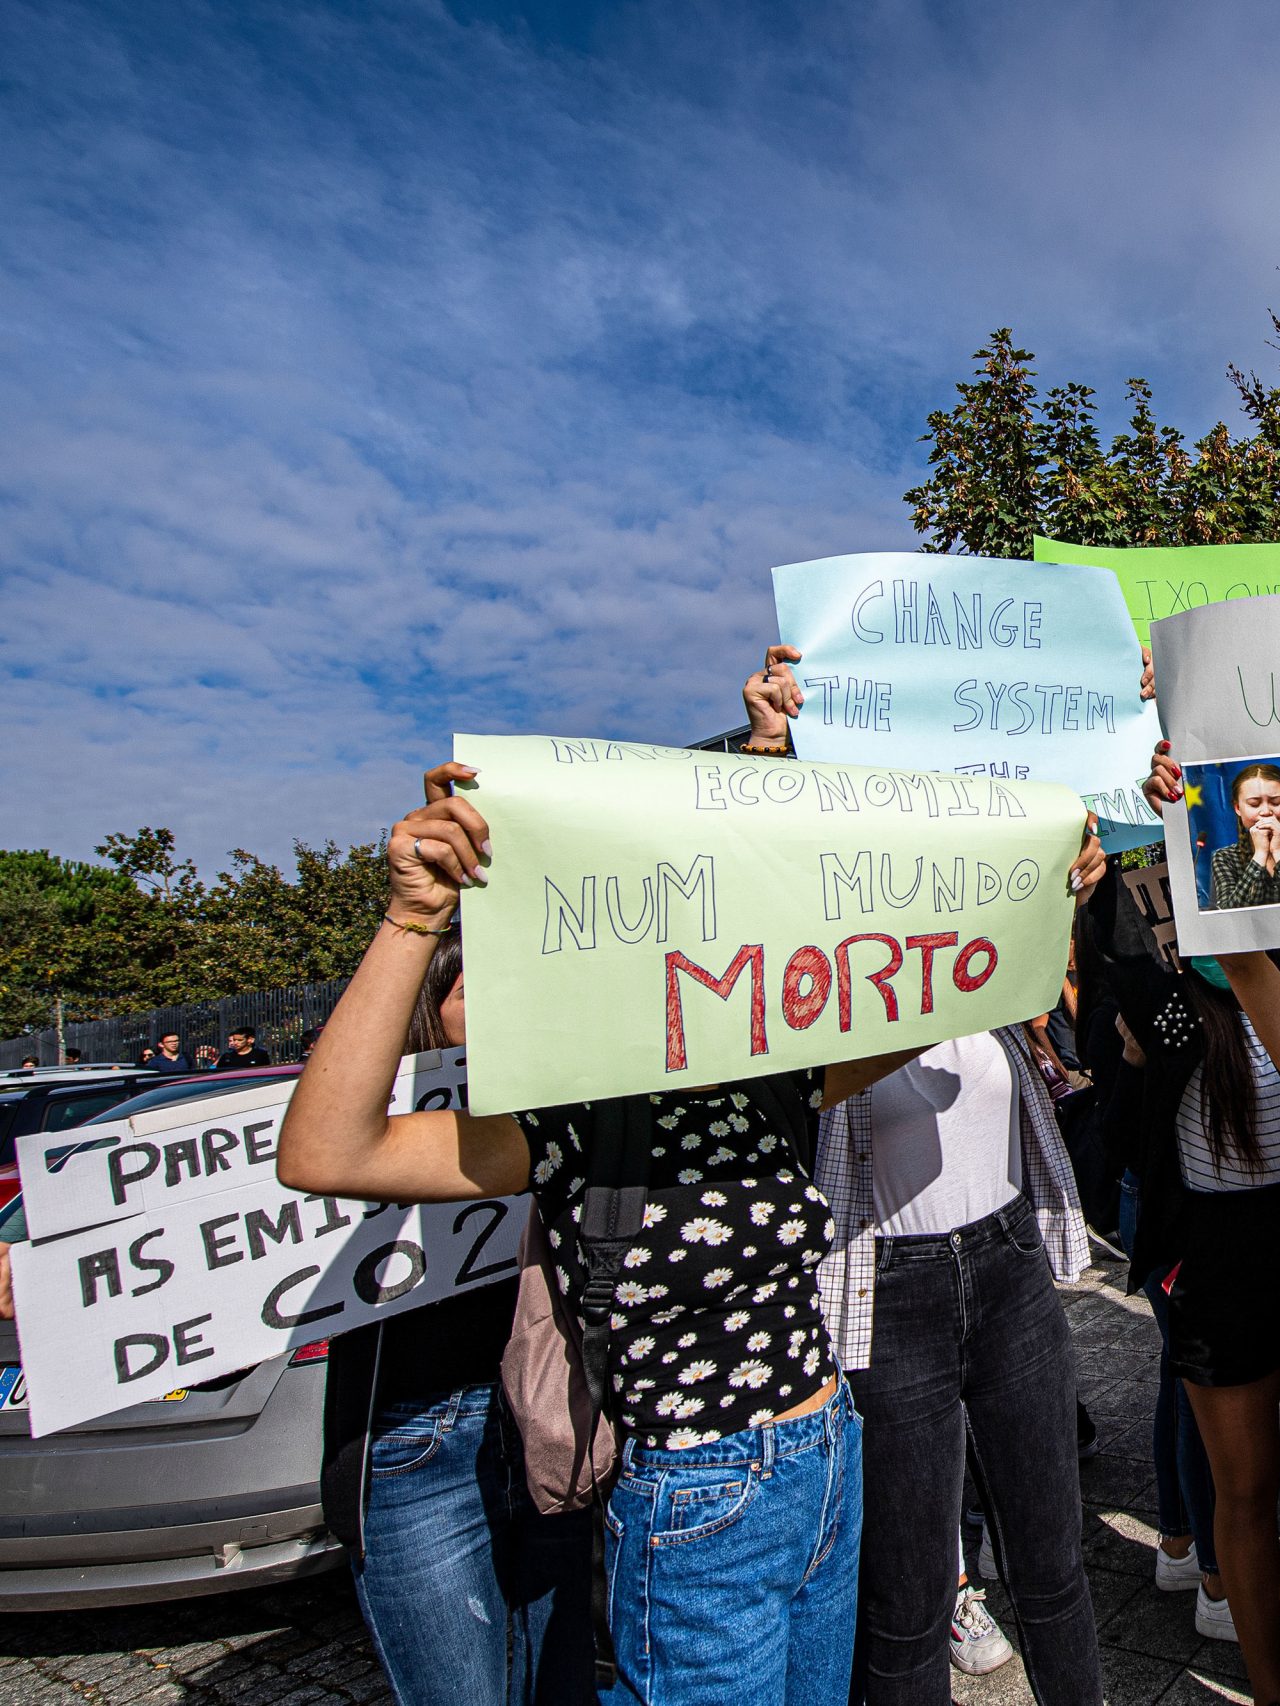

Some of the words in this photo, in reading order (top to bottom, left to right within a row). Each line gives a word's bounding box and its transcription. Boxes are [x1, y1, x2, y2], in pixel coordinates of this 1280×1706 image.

[851, 579, 1042, 650] CHANGE
[804, 675, 892, 732] THE
[953, 679, 1115, 735] SYSTEM
[695, 764, 1027, 818] ECONOMIA
[542, 854, 718, 954] NUM
[820, 851, 1041, 921] MUNDO
[665, 931, 998, 1073] MORTO
[78, 1227, 174, 1308] AS
[115, 1312, 214, 1385] DE
